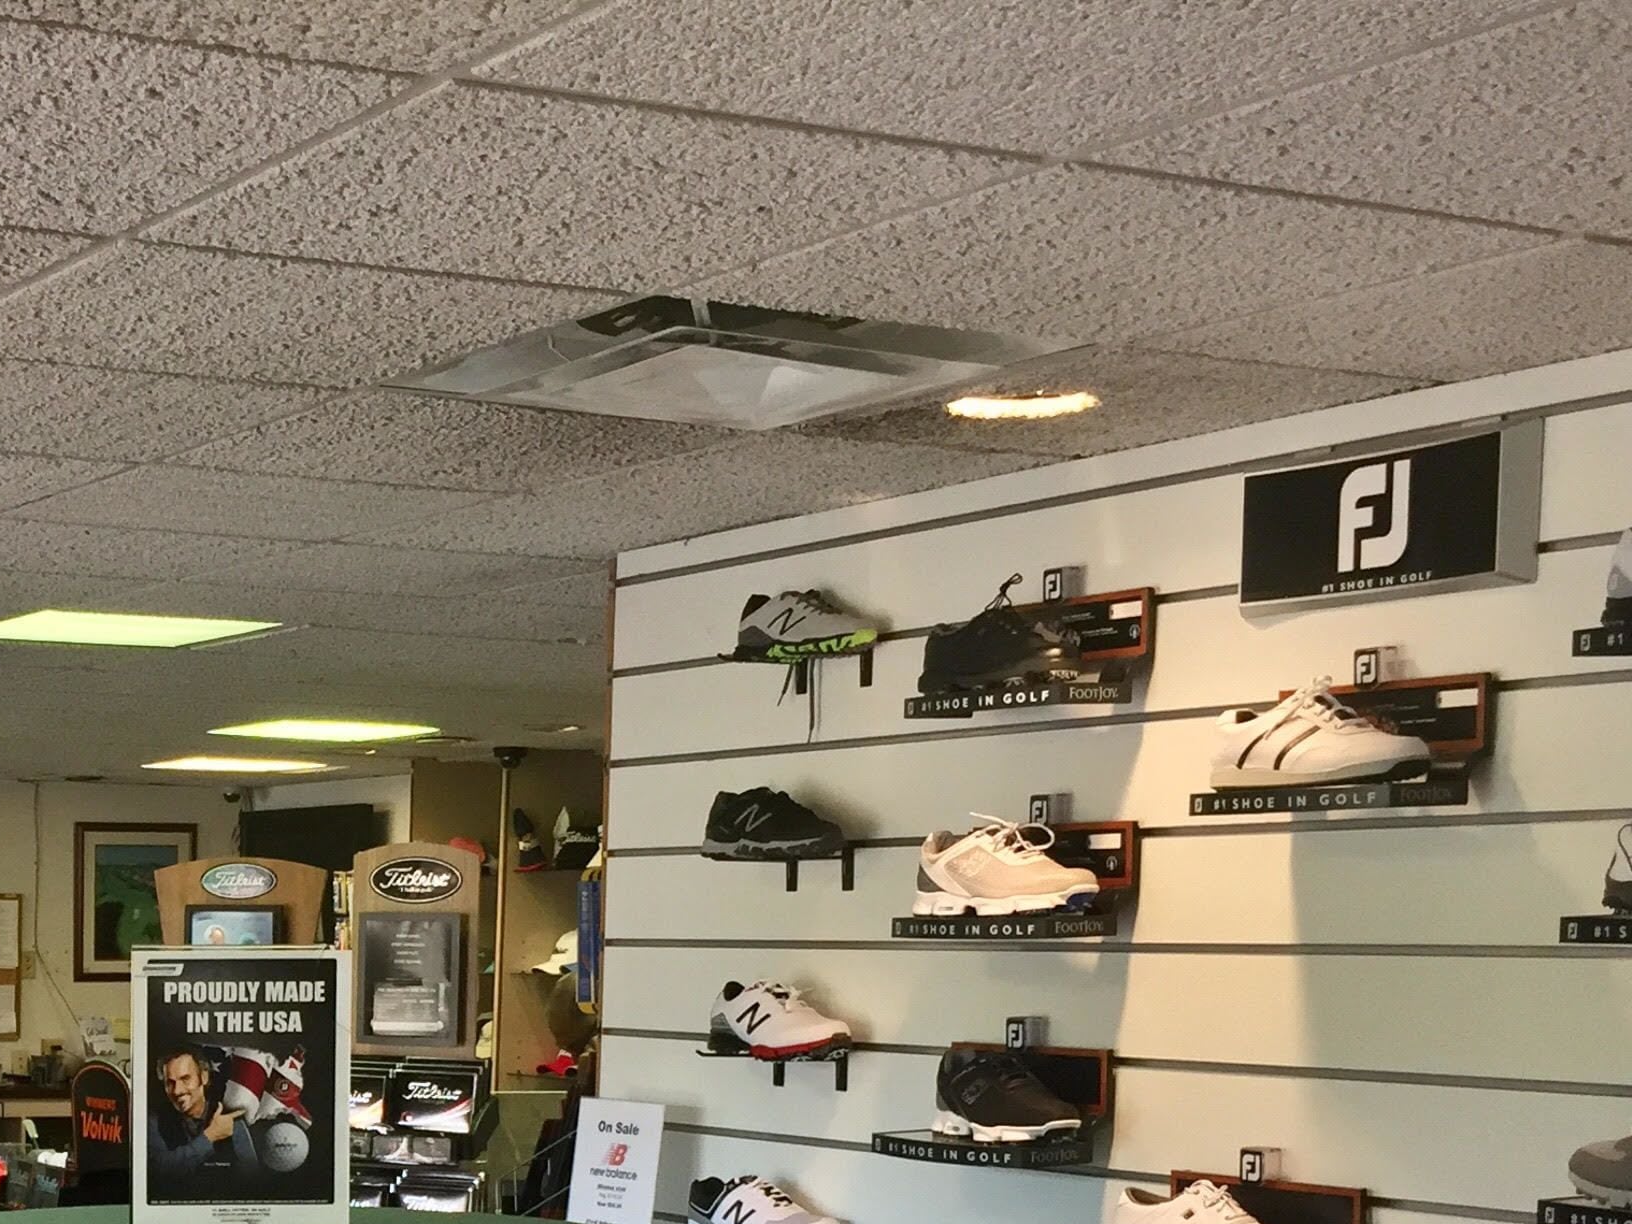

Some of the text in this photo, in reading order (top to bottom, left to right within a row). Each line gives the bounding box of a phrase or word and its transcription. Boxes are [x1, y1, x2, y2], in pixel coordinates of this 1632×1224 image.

[1337, 458, 1411, 573] FJ
[1046, 572, 1061, 600] FJ
[1340, 579, 1373, 592] SHOE
[1379, 575, 1395, 586] IN
[1400, 571, 1433, 584] GOLF
[1356, 653, 1377, 684] FJ
[935, 697, 969, 711] SHOE
[978, 694, 994, 707] IN
[1002, 689, 1051, 704] GOLF
[1232, 796, 1275, 810] SHOE
[1288, 794, 1306, 807] IN
[1319, 791, 1377, 805] GOLF
[379, 866, 451, 889] Titleist
[922, 923, 956, 936] SHOE
[965, 924, 980, 936] IN
[989, 923, 1037, 936] GOLF
[164, 980, 326, 1003] PROUDLY MADE
[186, 1011, 303, 1033] IN THE USA
[1007, 1023, 1024, 1049] FJ
[402, 1081, 463, 1101] Titleist
[80, 1111, 122, 1143] Volvik
[598, 1120, 640, 1136] On Sale
[902, 1143, 934, 1158] SHOE
[943, 1149, 958, 1160] IN
[967, 1150, 1012, 1164] GOLF
[1242, 1153, 1262, 1182] FJ
